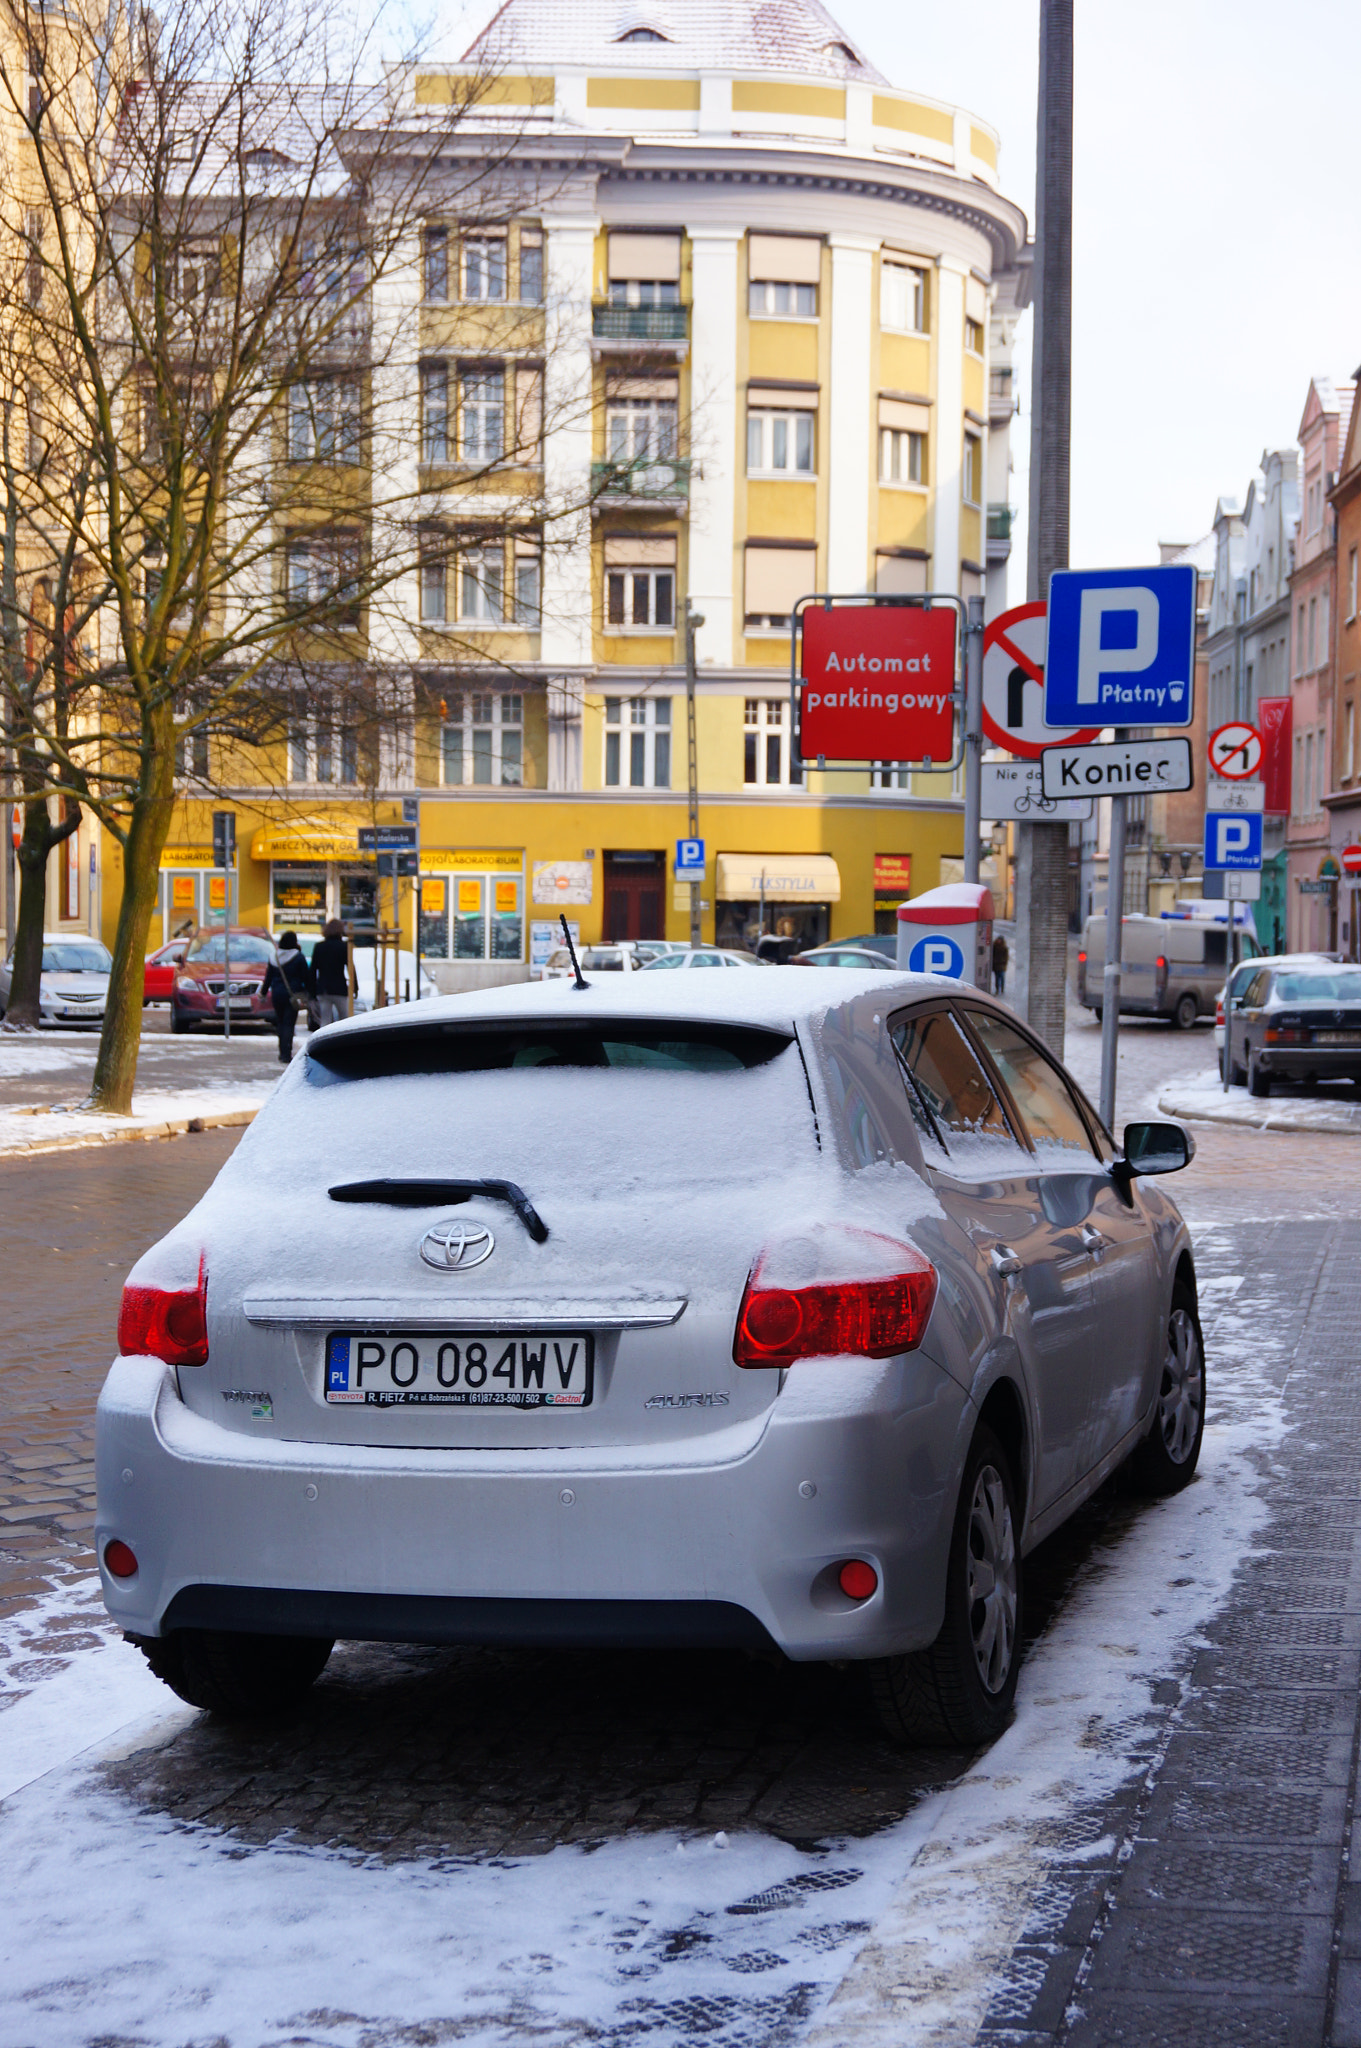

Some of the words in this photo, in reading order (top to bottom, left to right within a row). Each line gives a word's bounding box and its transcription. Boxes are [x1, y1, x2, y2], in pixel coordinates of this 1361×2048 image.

[1077, 586, 1160, 704] P
[825, 652, 931, 672] Automat
[807, 687, 947, 714] parkingowy
[1102, 683, 1167, 707] Płatny
[996, 769, 1018, 780] Nie
[1061, 754, 1170, 787] Koniec
[1216, 818, 1251, 864] P
[682, 842, 700, 865] P
[356, 1342, 419, 1387] PO
[437, 1342, 579, 1389] 084WV
[331, 1372, 346, 1384] PL
[368, 1393, 378, 1402] R.
[380, 1393, 405, 1402] FIETZ
[554, 1394, 582, 1404] Castrol
[645, 1391, 730, 1409] AURIS
